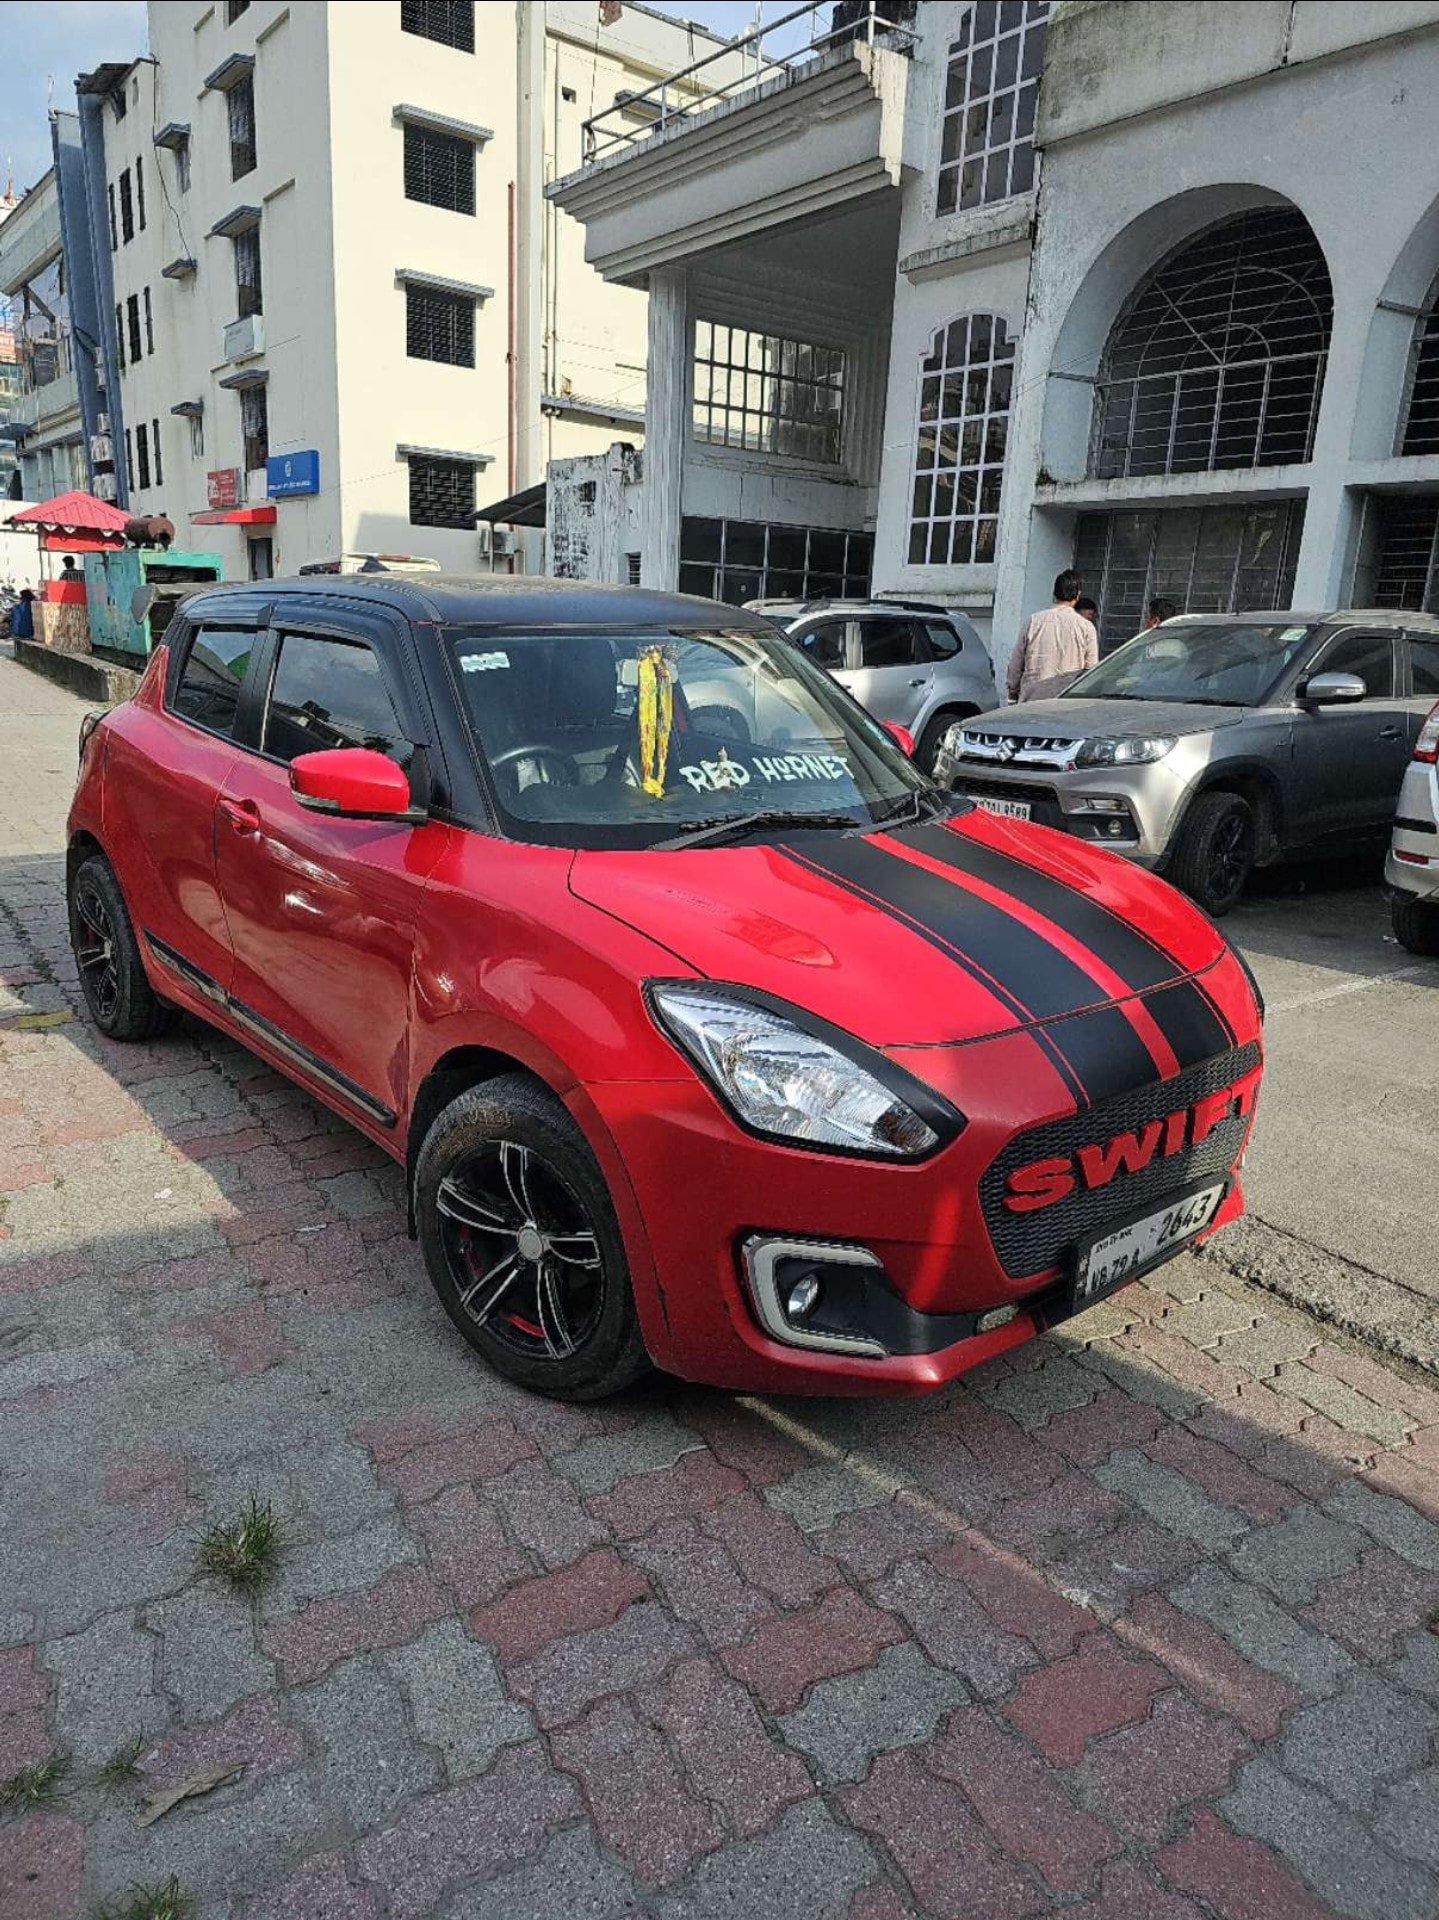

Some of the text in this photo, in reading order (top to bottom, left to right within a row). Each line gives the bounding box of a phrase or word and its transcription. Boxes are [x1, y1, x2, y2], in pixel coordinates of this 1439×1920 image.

[679, 754, 854, 793] RED HORNET
[1002, 1063, 1263, 1212] SWIFT
[1155, 1193, 1212, 1246] 2643
